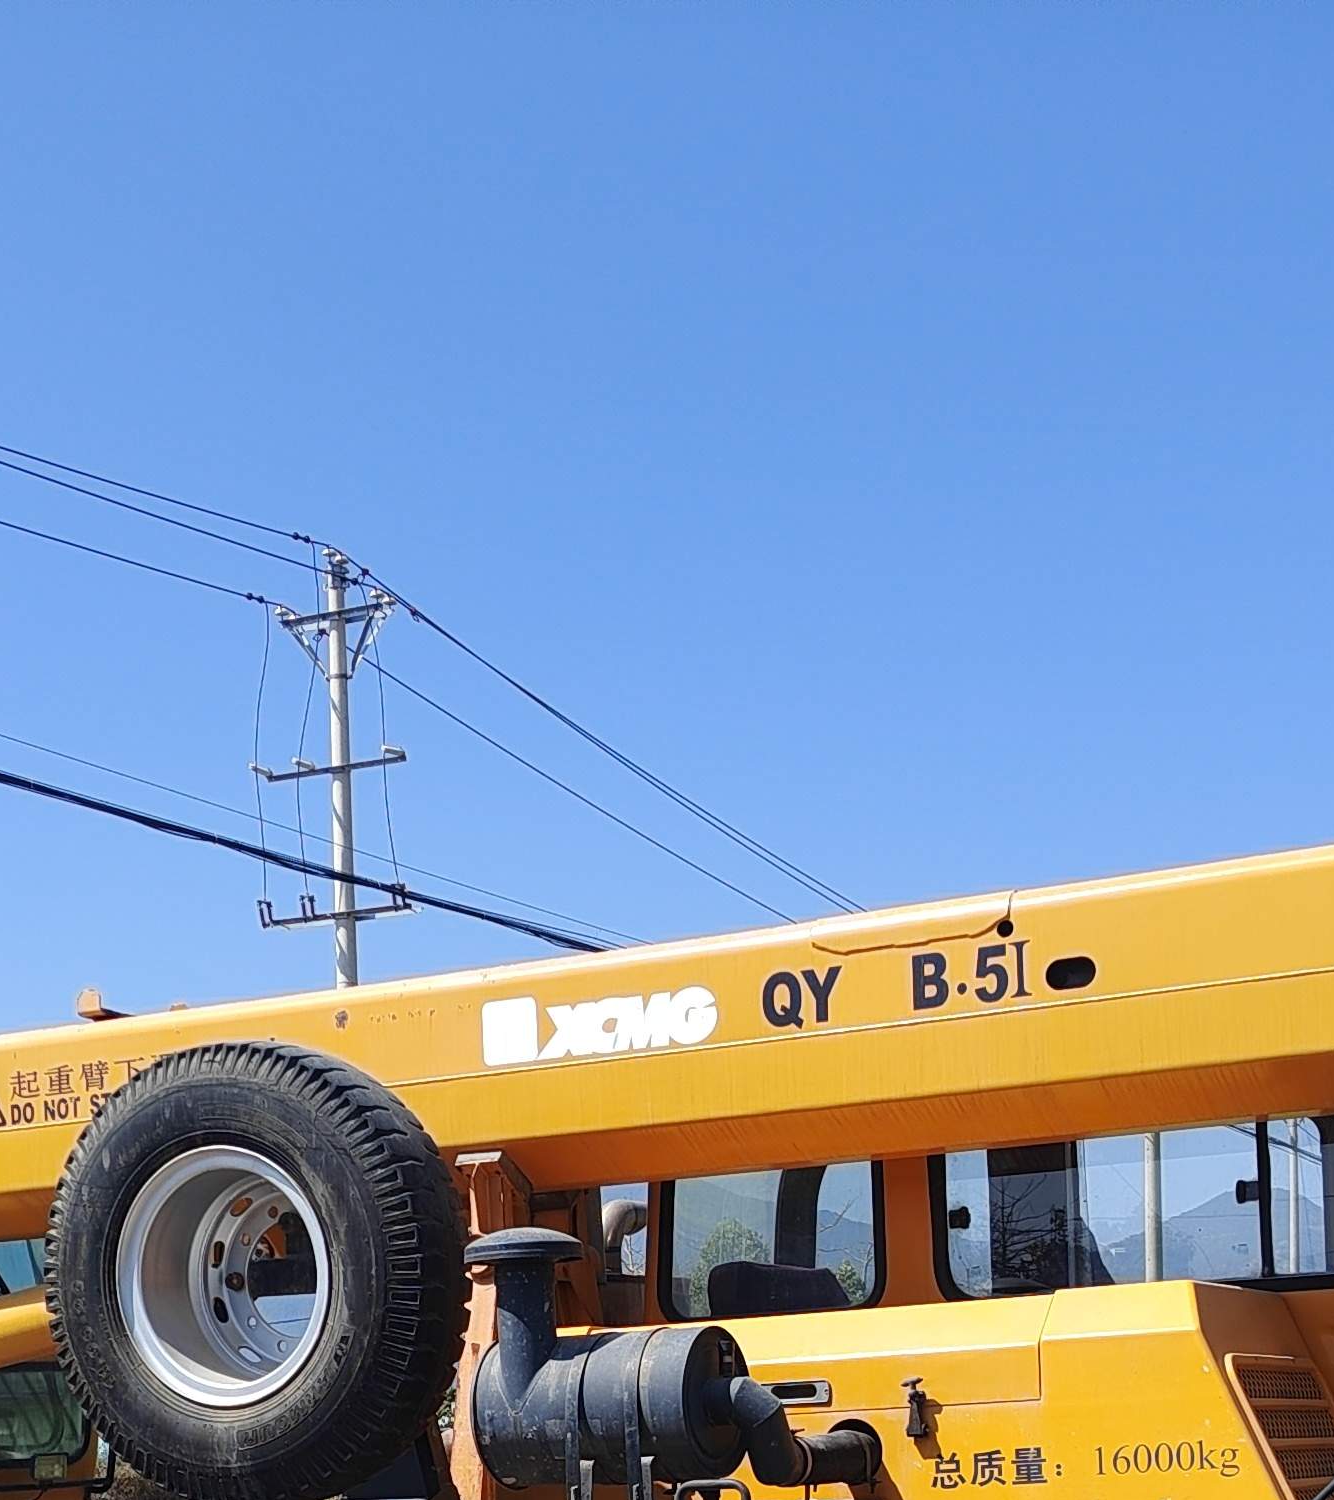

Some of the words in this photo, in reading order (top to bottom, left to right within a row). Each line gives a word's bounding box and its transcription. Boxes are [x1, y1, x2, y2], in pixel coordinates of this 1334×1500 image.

[762, 965, 843, 1029] QY
[535, 984, 719, 1060] XCMG
[9, 1053, 167, 1101] 起重臂下
[10, 1102, 35, 1125] DO
[43, 1096, 81, 1122] NOT
[1094, 1439, 1241, 1478] 16000kg
